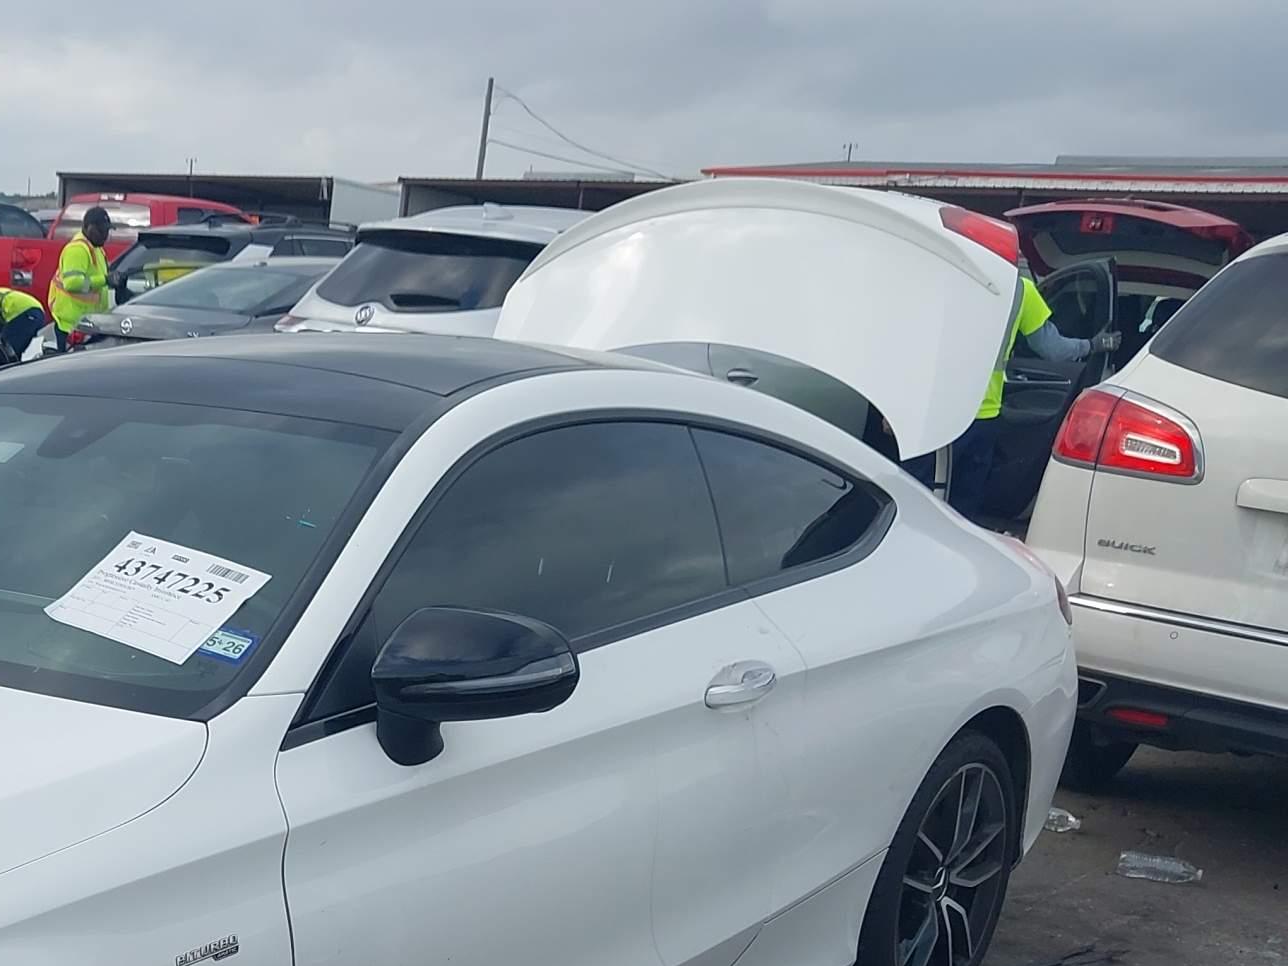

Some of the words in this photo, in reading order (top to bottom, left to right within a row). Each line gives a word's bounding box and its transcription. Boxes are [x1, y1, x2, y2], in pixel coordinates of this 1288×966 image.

[1097, 539, 1156, 555] BUICK
[114, 556, 230, 604] 43747225
[222, 641, 245, 655] 26
